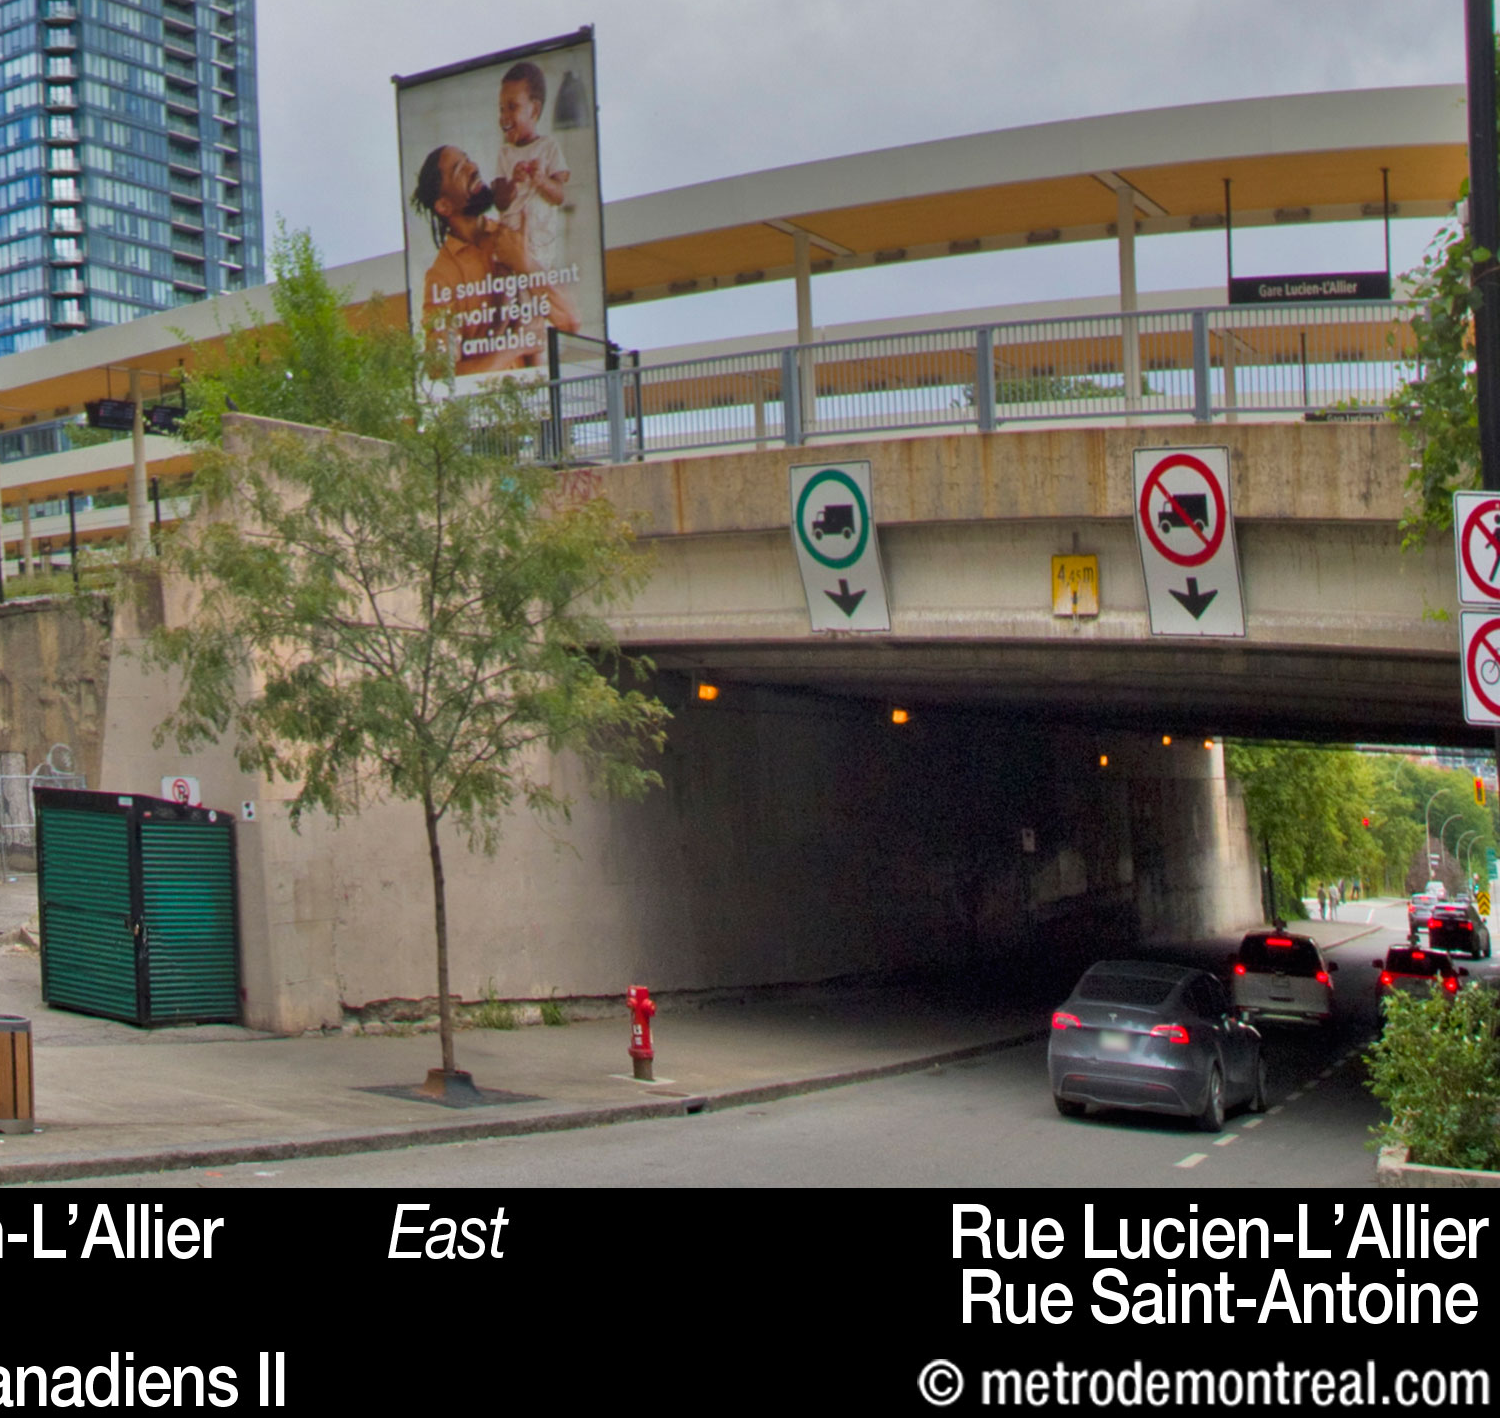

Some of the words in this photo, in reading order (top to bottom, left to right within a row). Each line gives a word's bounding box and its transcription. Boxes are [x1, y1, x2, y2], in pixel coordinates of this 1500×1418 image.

[432, 283, 452, 304] Le
[456, 262, 580, 298] soulagement
[1258, 283, 1283, 298] Gare
[1285, 280, 1358, 297] Lucien-L'Allier
[501, 293, 551, 325] réglé
[456, 326, 544, 357] 'amiable.
